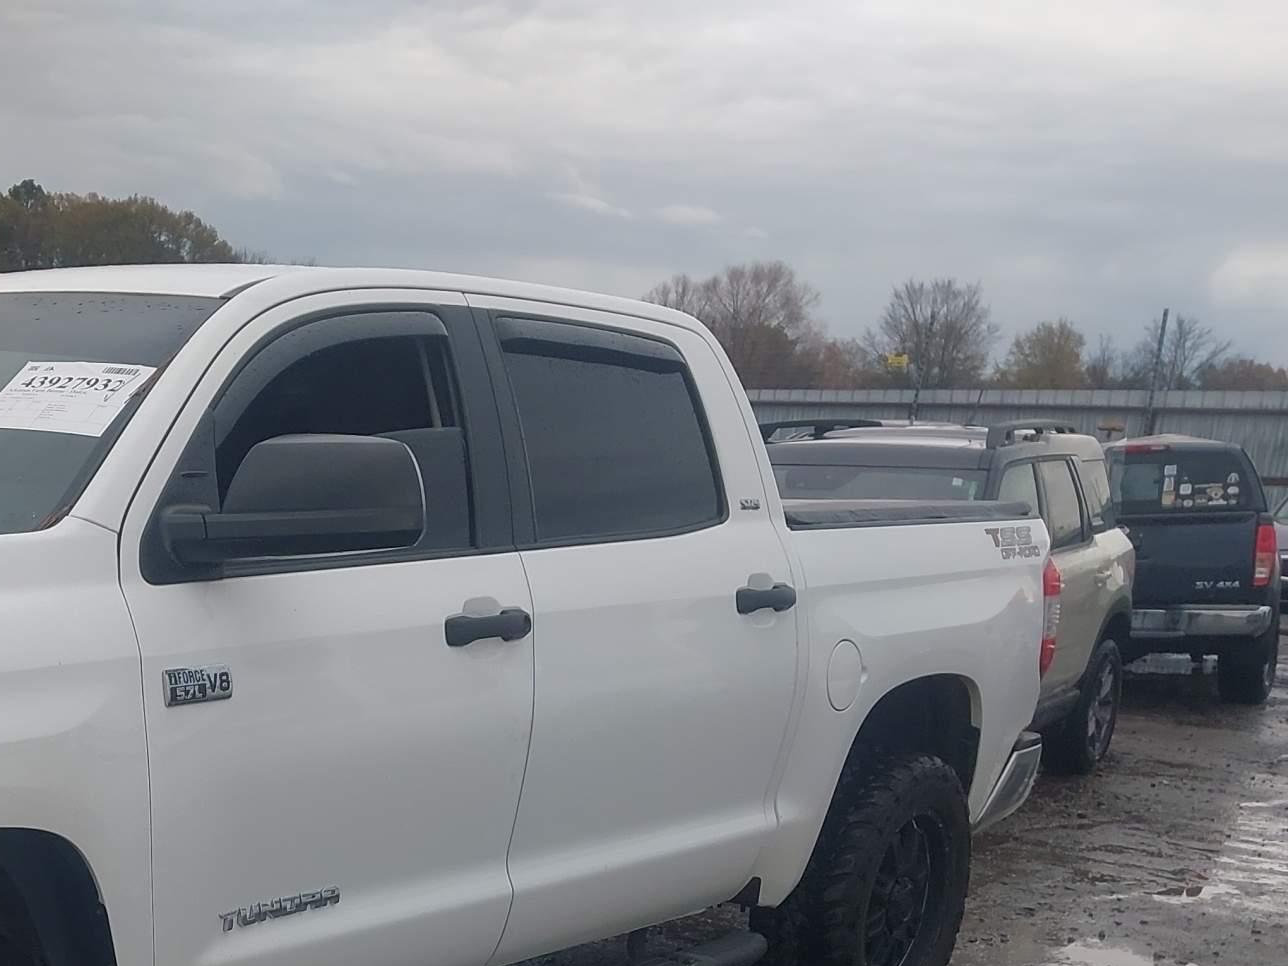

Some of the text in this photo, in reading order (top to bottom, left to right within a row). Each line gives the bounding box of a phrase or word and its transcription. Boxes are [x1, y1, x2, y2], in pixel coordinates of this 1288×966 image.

[20, 375, 126, 392] 43927932
[983, 525, 1033, 548] TSS
[205, 671, 231, 693] V8
[218, 885, 341, 932] TUNDRA
